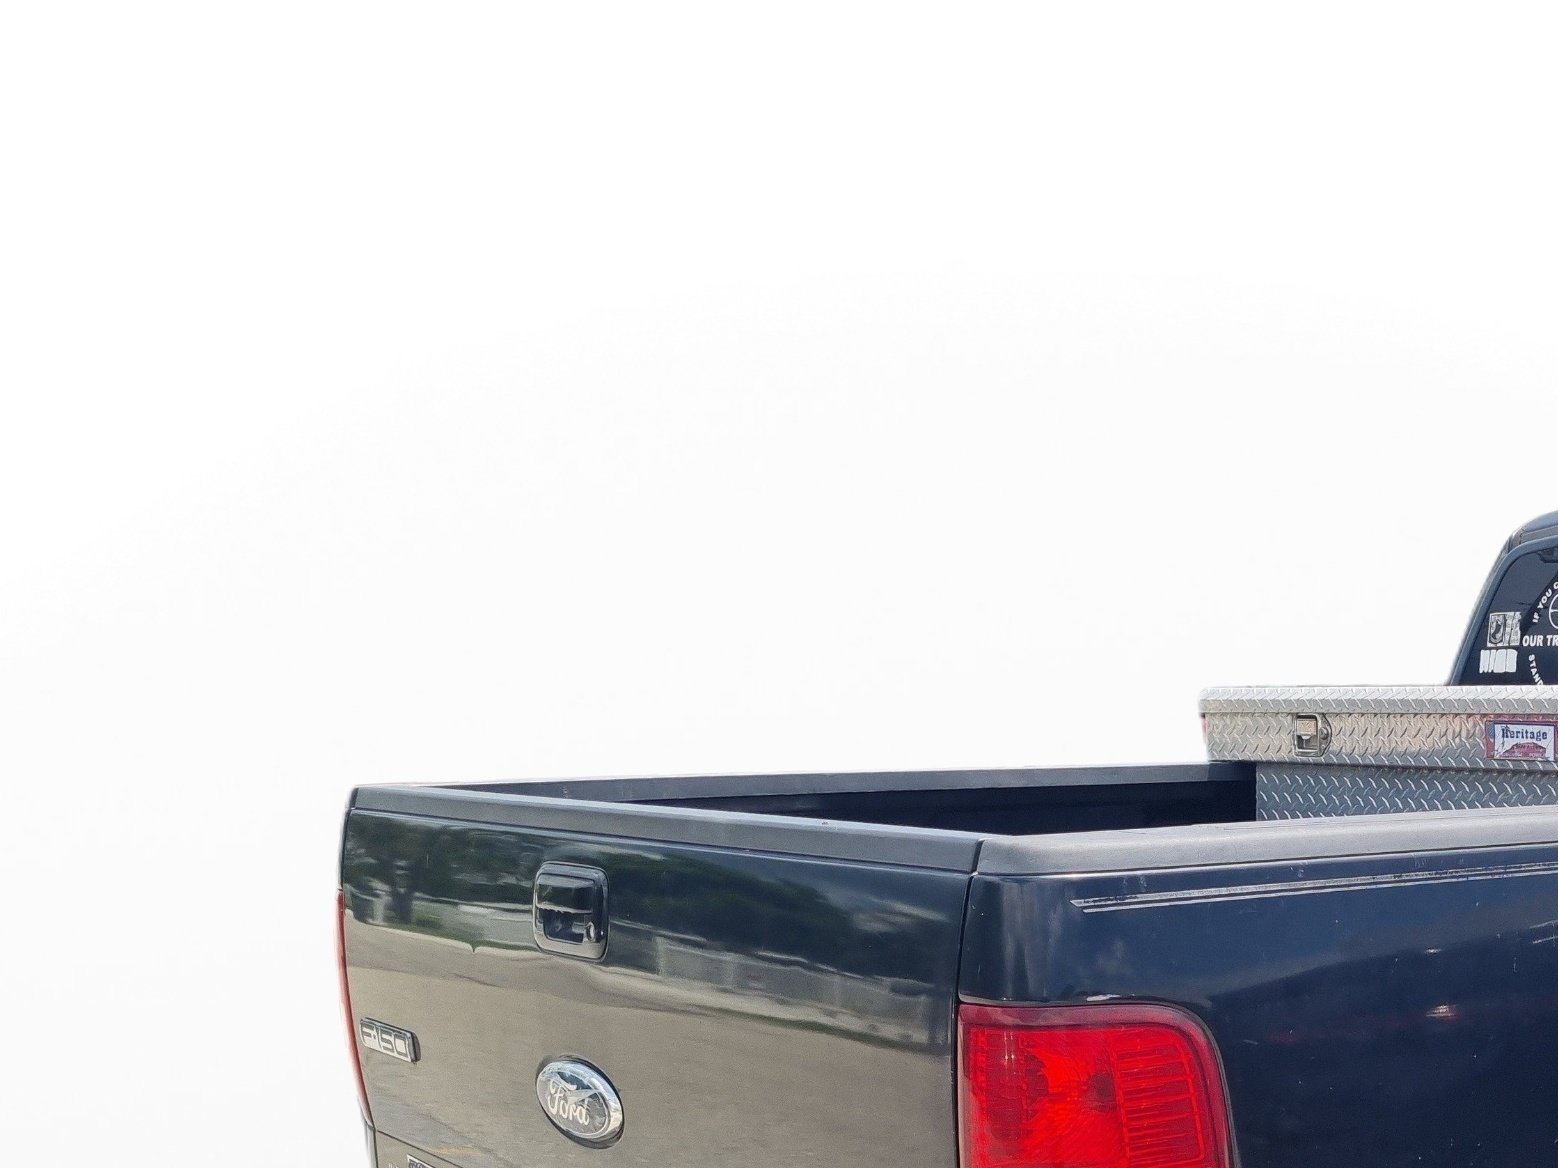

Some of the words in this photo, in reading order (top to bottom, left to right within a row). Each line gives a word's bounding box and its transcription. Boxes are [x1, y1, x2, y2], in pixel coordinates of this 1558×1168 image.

[1532, 612, 1540, 623] IF
[1537, 588, 1552, 609] YOU
[1522, 634, 1544, 647] OUR
[1501, 726, 1548, 741] Heritage
[547, 1077, 591, 1126] Ford
